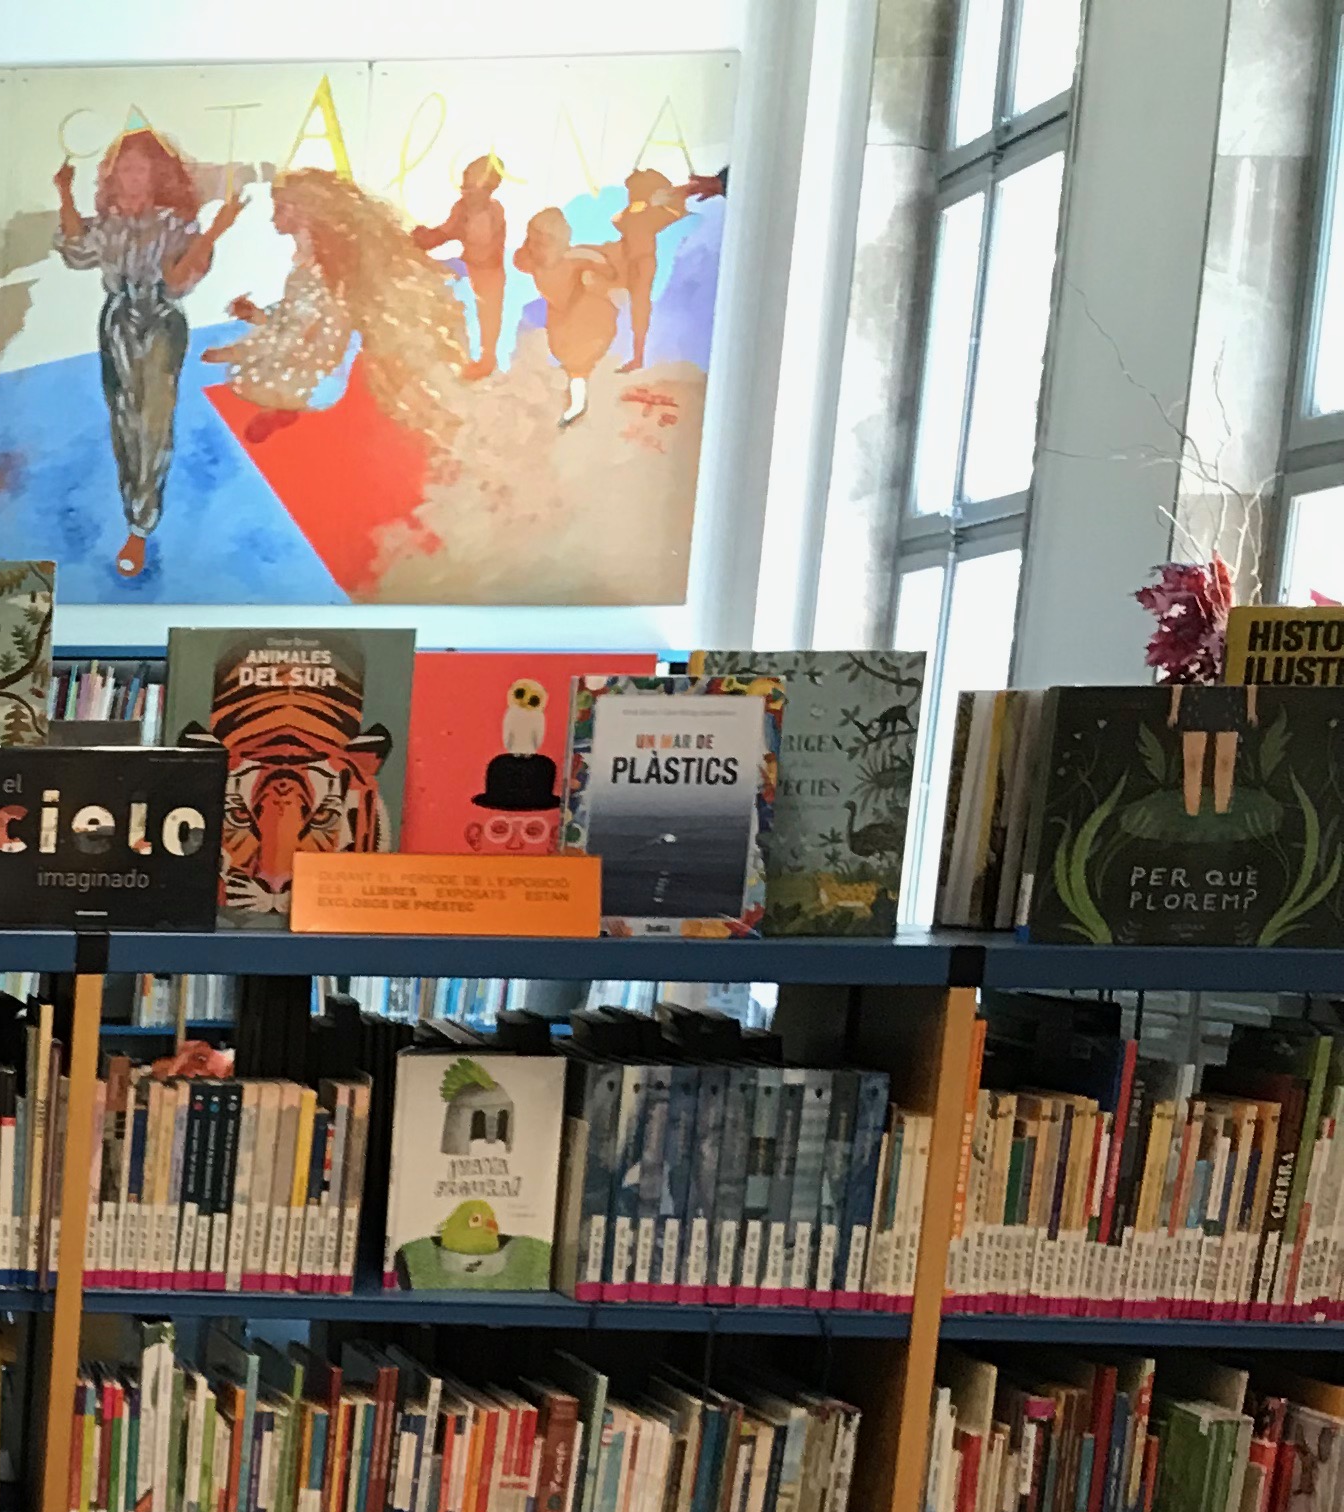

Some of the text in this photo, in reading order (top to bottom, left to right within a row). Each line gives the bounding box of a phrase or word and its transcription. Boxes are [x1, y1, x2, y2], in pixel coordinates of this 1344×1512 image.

[1248, 620, 1344, 652] HISTO
[246, 649, 332, 667] ANIMALES
[238, 666, 338, 688] DEL SUR
[1244, 656, 1344, 686] ILUST
[636, 734, 655, 749] UN
[696, 733, 715, 749] DE
[782, 733, 843, 752] RIGEN
[611, 750, 739, 785] PLÀSTICS
[2, 774, 23, 794] el
[37, 866, 150, 890] imaginado
[1130, 865, 1259, 888] PER QUÈ
[1129, 888, 1258, 911] PLOREM?
[1271, 1152, 1295, 1219] GUERRA
